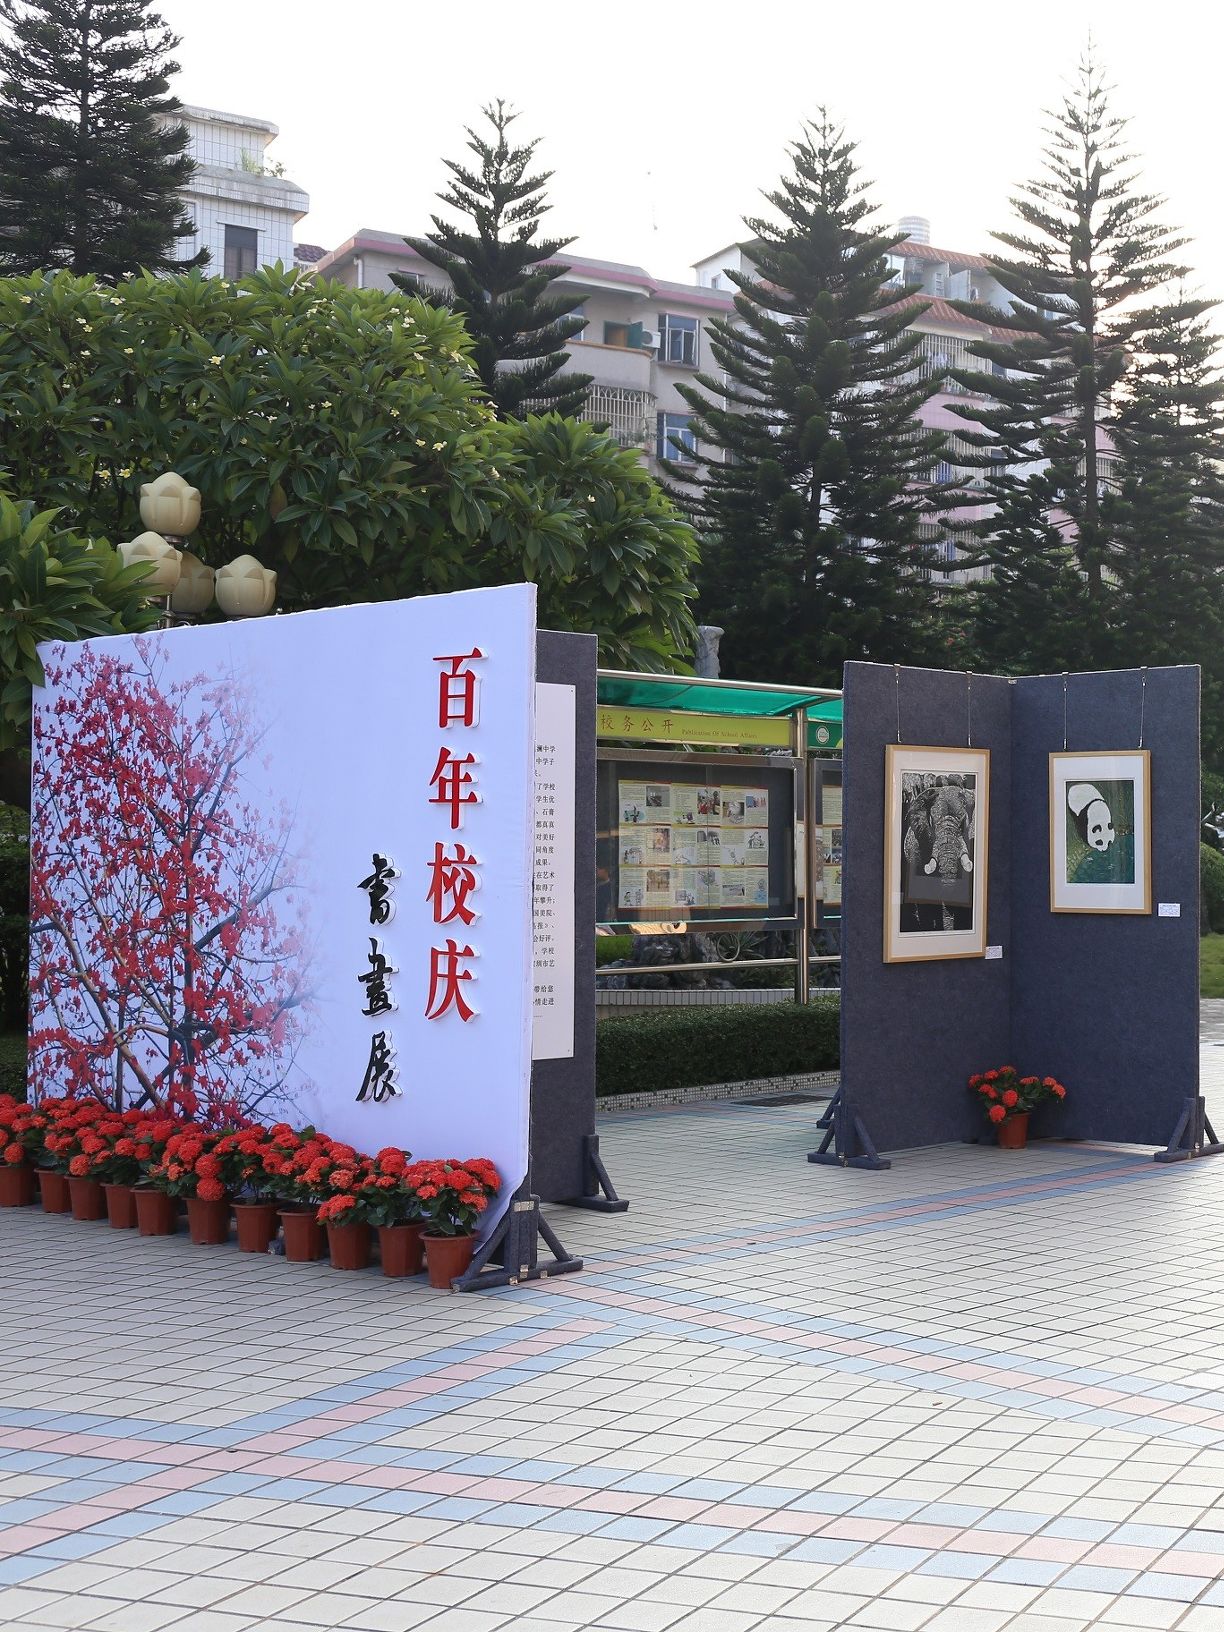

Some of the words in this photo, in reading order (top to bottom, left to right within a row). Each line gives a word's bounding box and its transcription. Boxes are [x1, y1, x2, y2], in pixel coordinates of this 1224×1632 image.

[600, 714, 675, 734] 校务公开
[425, 647, 487, 1023] 百年校庆
